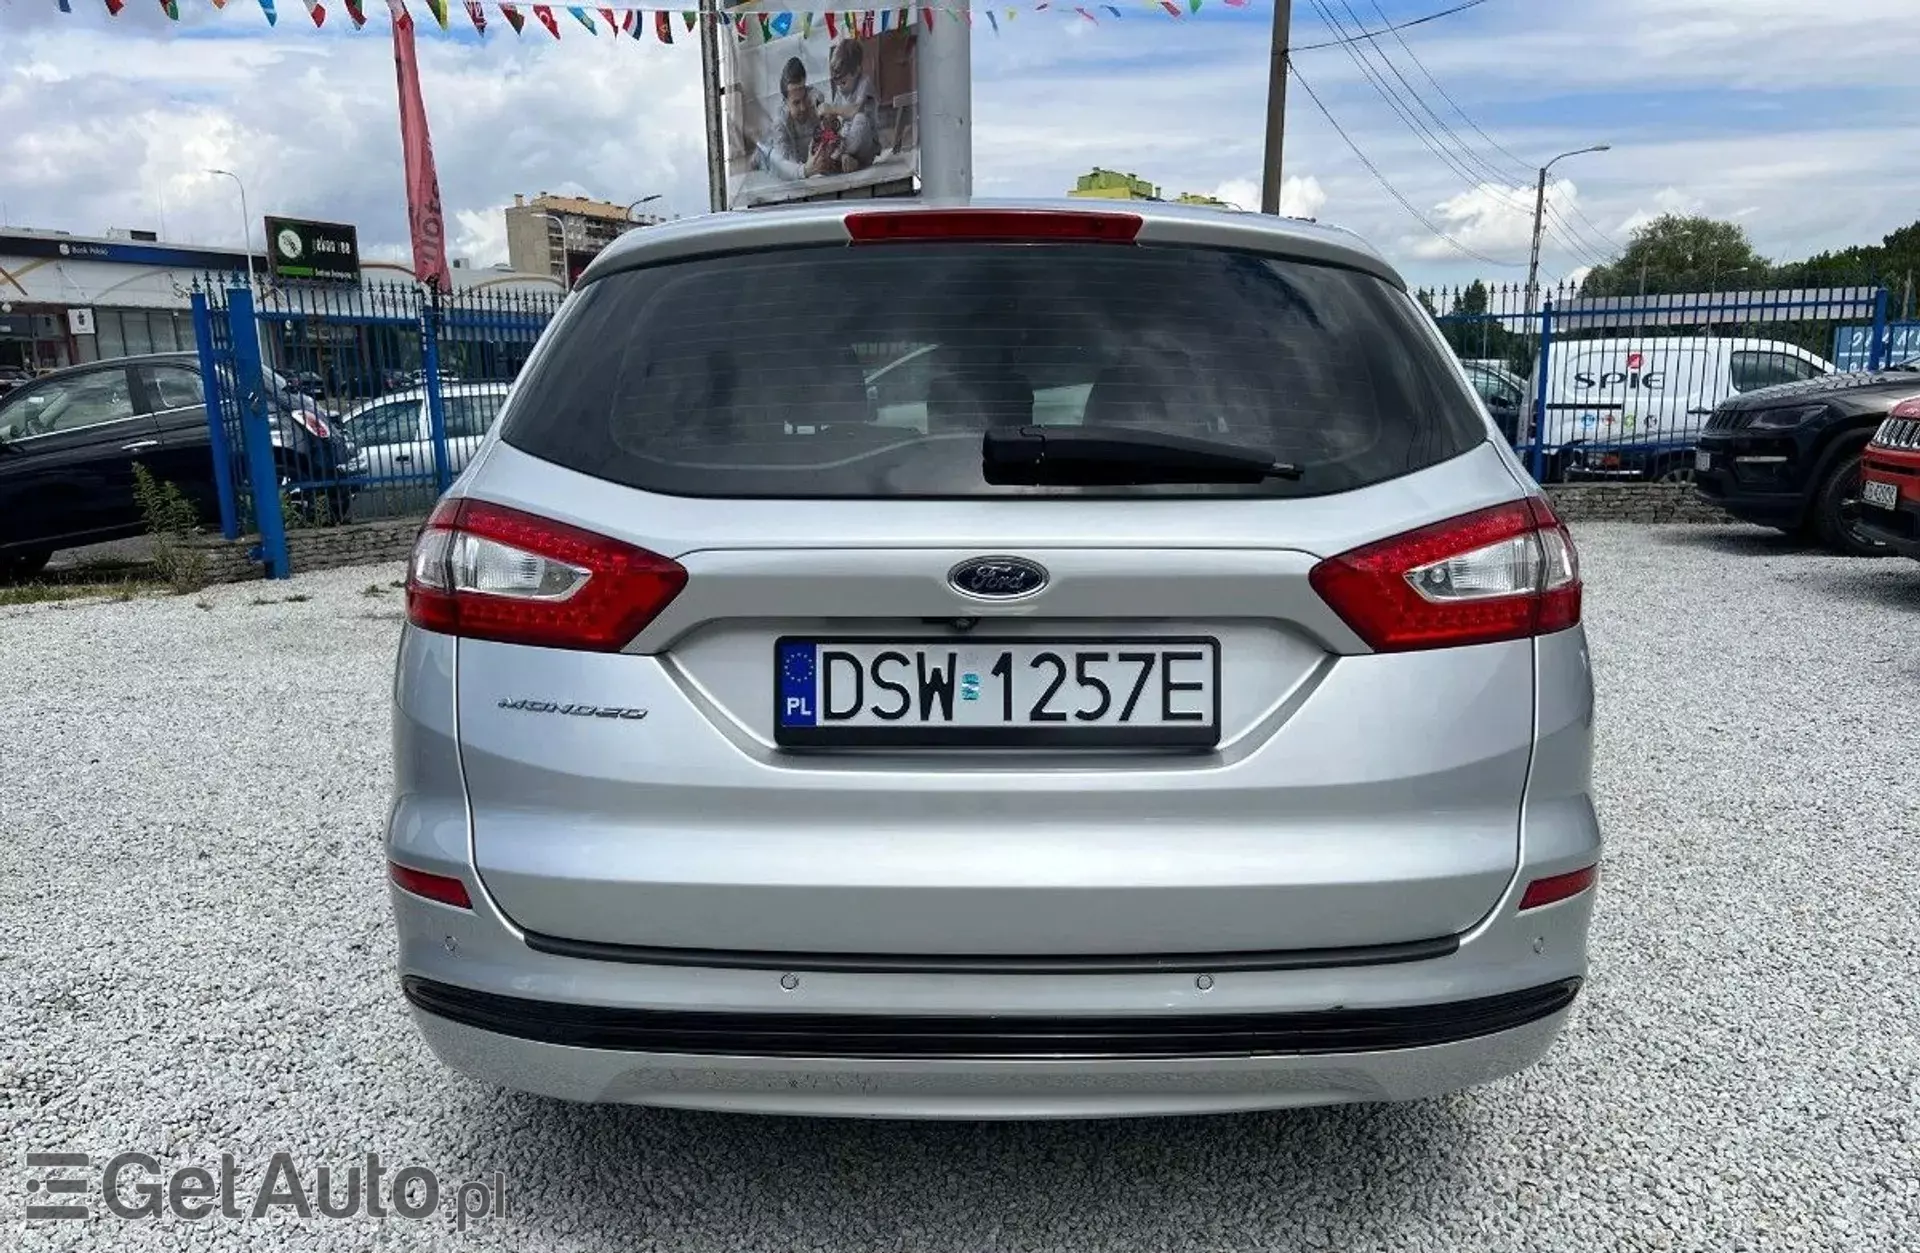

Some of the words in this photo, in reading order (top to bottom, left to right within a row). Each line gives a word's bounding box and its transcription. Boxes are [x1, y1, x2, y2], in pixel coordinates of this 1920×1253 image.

[967, 563, 1030, 591] Ford
[823, 651, 957, 721] DSW
[992, 651, 1204, 721] 1257E
[497, 697, 649, 719] MONDEO
[787, 698, 812, 716] PL
